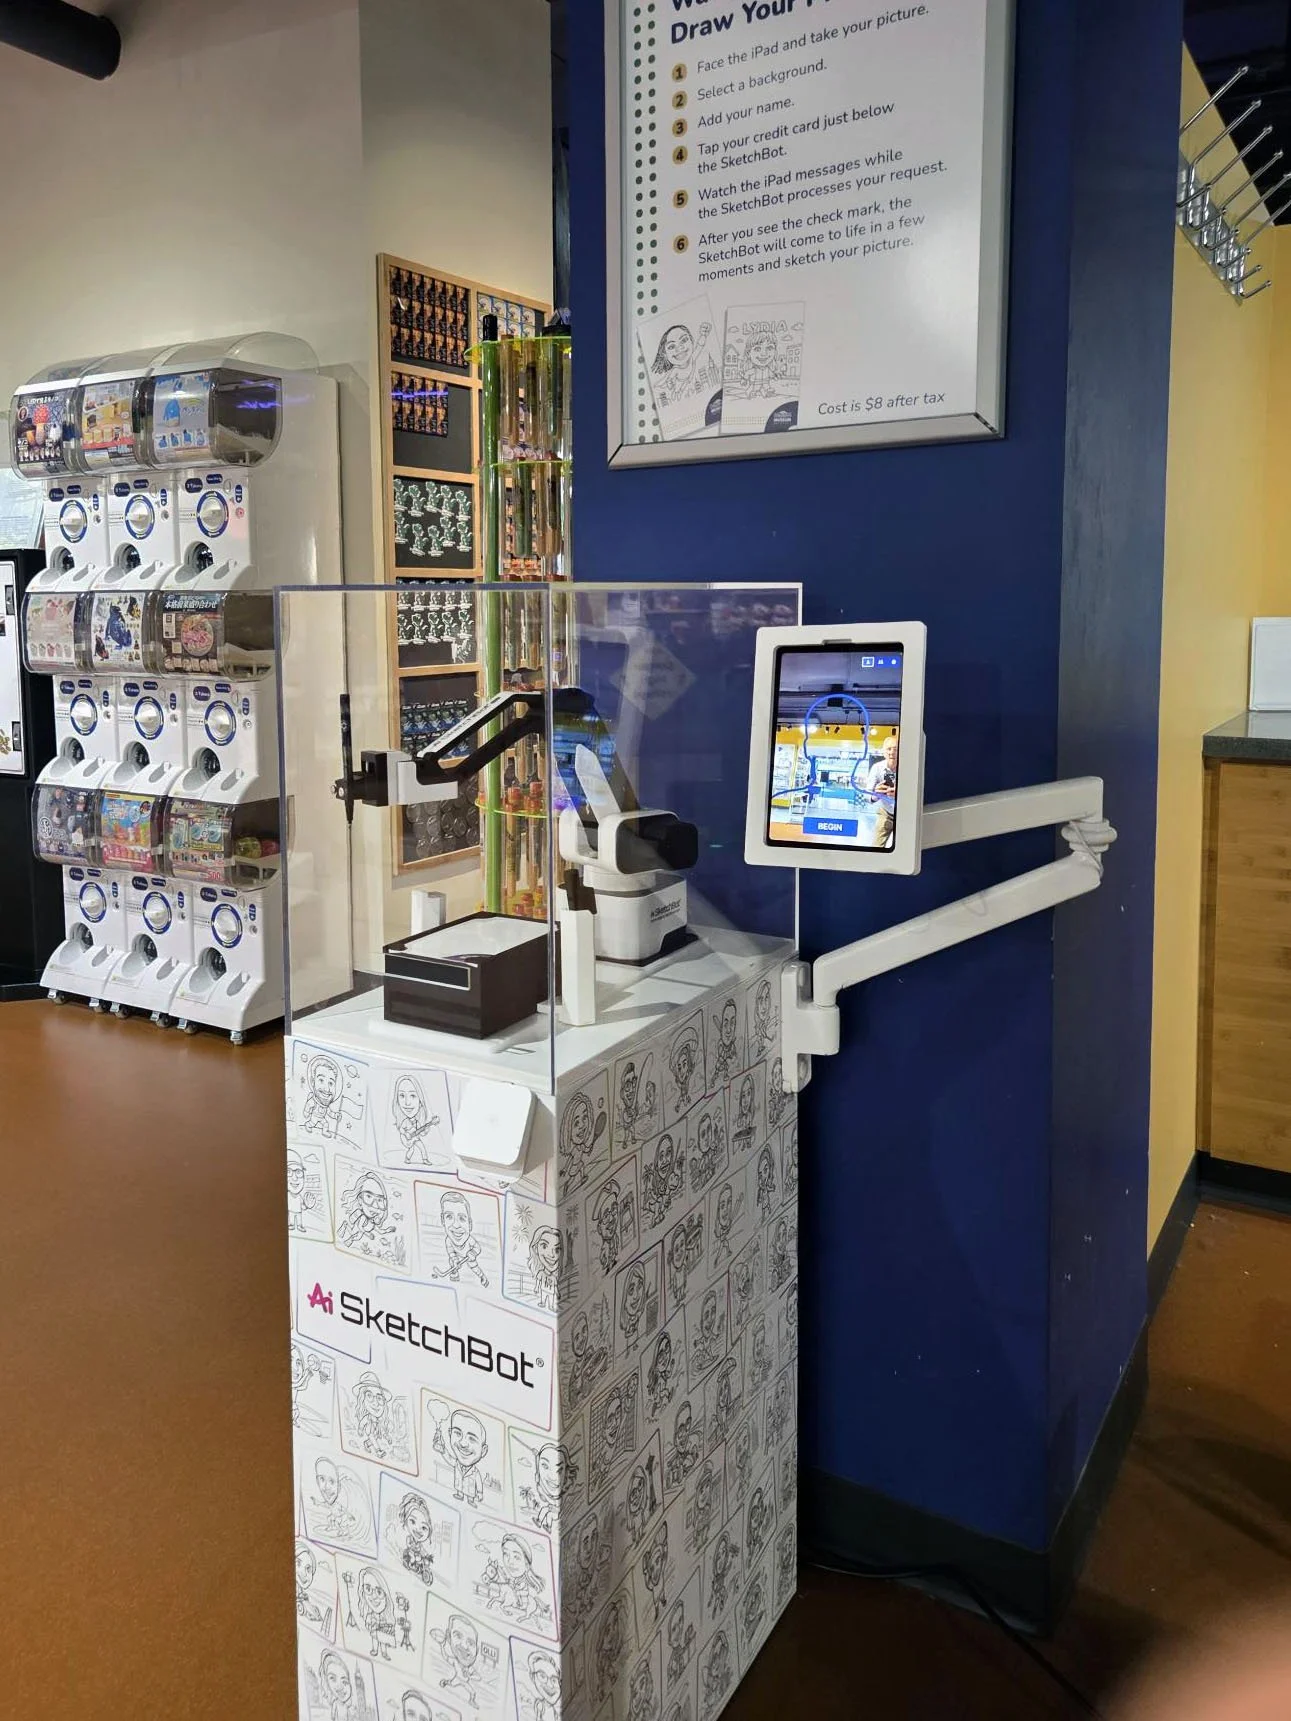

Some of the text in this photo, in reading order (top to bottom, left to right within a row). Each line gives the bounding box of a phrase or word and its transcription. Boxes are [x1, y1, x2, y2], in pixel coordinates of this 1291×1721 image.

[671, 0, 796, 44] Draw Your
[697, 58, 725, 74] Face
[728, 51, 748, 66] the
[751, 42, 779, 60] iPad
[782, 33, 807, 51] and
[810, 27, 839, 44] take
[842, 19, 872, 39] your
[876, 5, 929, 29] picture.
[697, 82, 735, 101] Select
[738, 82, 745, 91] a
[749, 58, 828, 88] background.
[697, 115, 722, 128] Add
[726, 107, 752, 124] your
[756, 98, 795, 115] name.
[697, 142, 719, 156] Tap
[722, 135, 750, 151] your
[753, 125, 789, 143] credit
[792, 117, 820, 134] card
[823, 112, 848, 130] just
[852, 103, 895, 121] below
[698, 145, 787, 175] the SketchBot.
[698, 183, 737, 201] Watch
[741, 177, 760, 191] the
[764, 171, 791, 187] iPad
[796, 159, 861, 181] messages
[865, 149, 903, 167] while
[698, 160, 947, 219] the SketchBot processes your request.
[698, 232, 729, 246] After
[732, 228, 753, 242] you
[757, 224, 778, 236] see
[782, 217, 803, 231] the
[806, 208, 843, 226] check
[889, 197, 912, 210] the
[698, 215, 925, 264] SketchBot will come to life in a few
[698, 236, 914, 282] moments and sketch your picture.
[742, 320, 788, 335] LYDIA
[818, 392, 945, 415] Cost is $8 after tax
[817, 822, 843, 832] BEGIN
[307, 1282, 334, 1315] Ai
